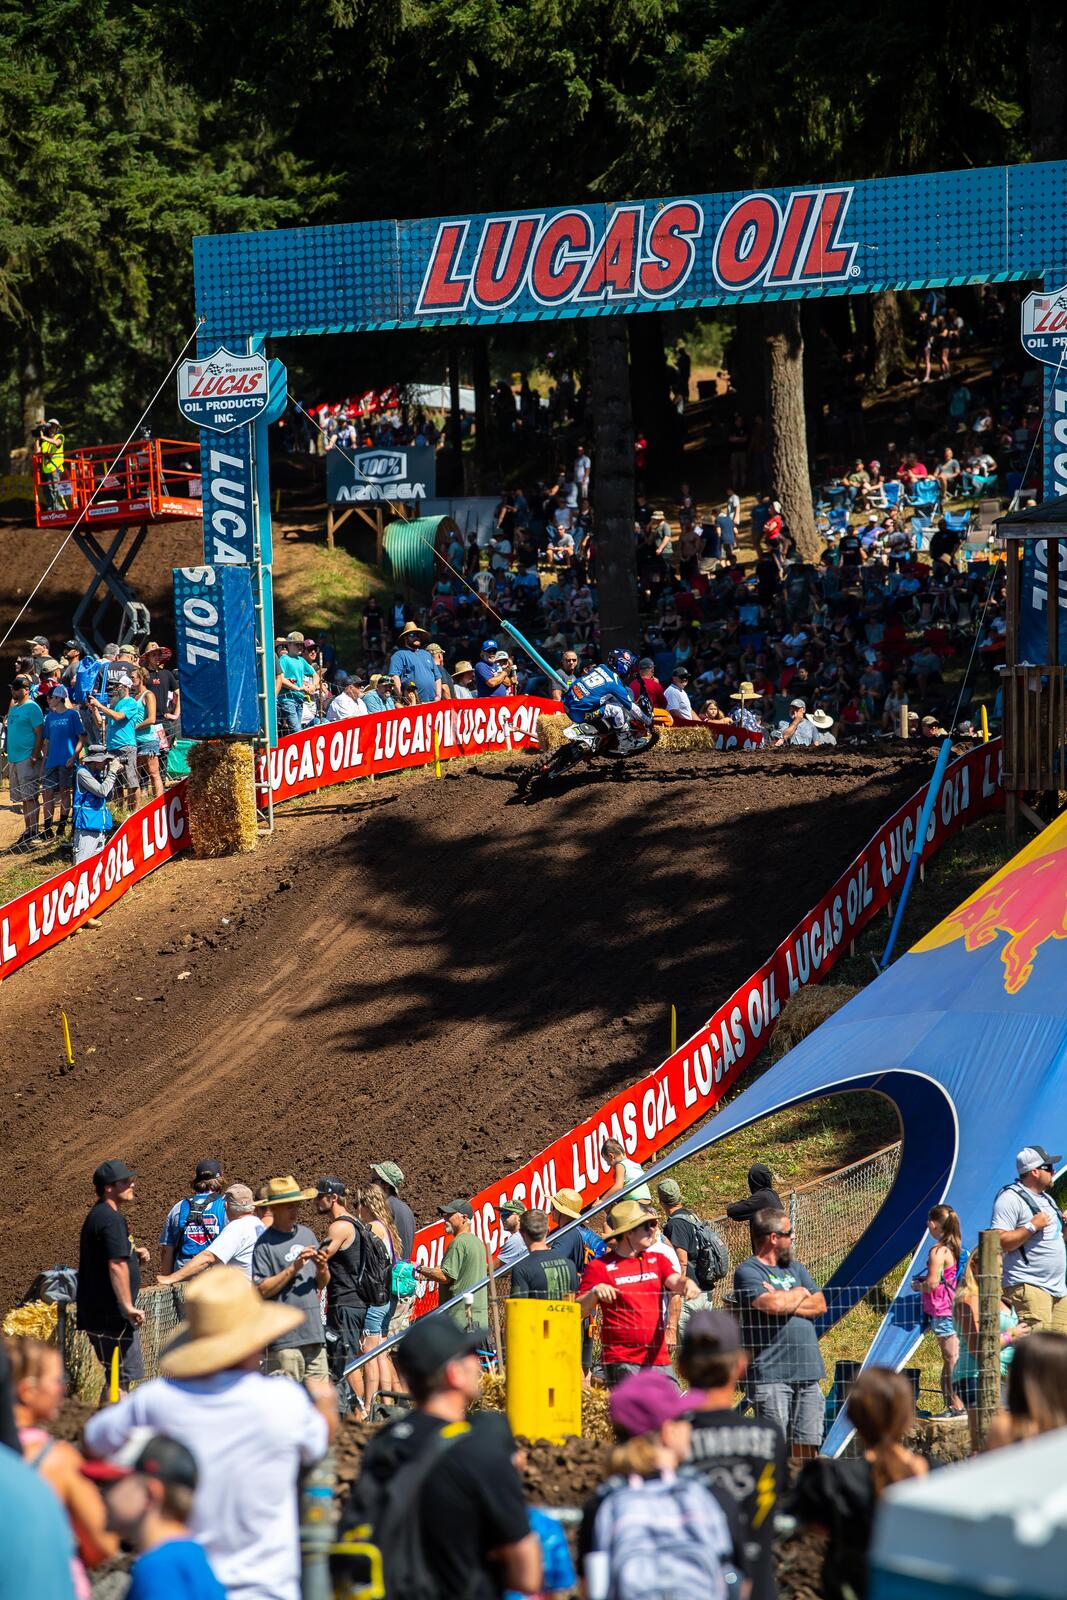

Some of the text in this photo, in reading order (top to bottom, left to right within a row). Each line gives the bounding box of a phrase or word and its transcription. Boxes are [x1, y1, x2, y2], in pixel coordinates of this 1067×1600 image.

[414, 186, 858, 314] LUCAS OIL
[1027, 338, 1048, 348] OIL
[189, 373, 263, 397] LUCAS
[184, 398, 264, 412] OIL PRODUCTS
[214, 413, 237, 423] INC.
[361, 458, 400, 475] 100%
[336, 483, 425, 501] ARMEGA
[183, 598, 220, 666] OIL
[329, 727, 363, 772] OIL
[373, 714, 432, 760] LUCAS
[457, 706, 511, 744] LUCAS
[513, 704, 541, 743] OIL
[28, 856, 103, 946] LUCAS
[104, 834, 135, 891] OIL
[142, 796, 184, 861] LUC
[642, 1075, 677, 1140] OIL
[683, 1006, 746, 1109] LUCAS
[747, 970, 781, 1039] OIL
[785, 895, 843, 994] LUCAS
[847, 861, 873, 926] OIL
[941, 765, 970, 826] OIL
[614, 1271, 659, 1286] HONDA
